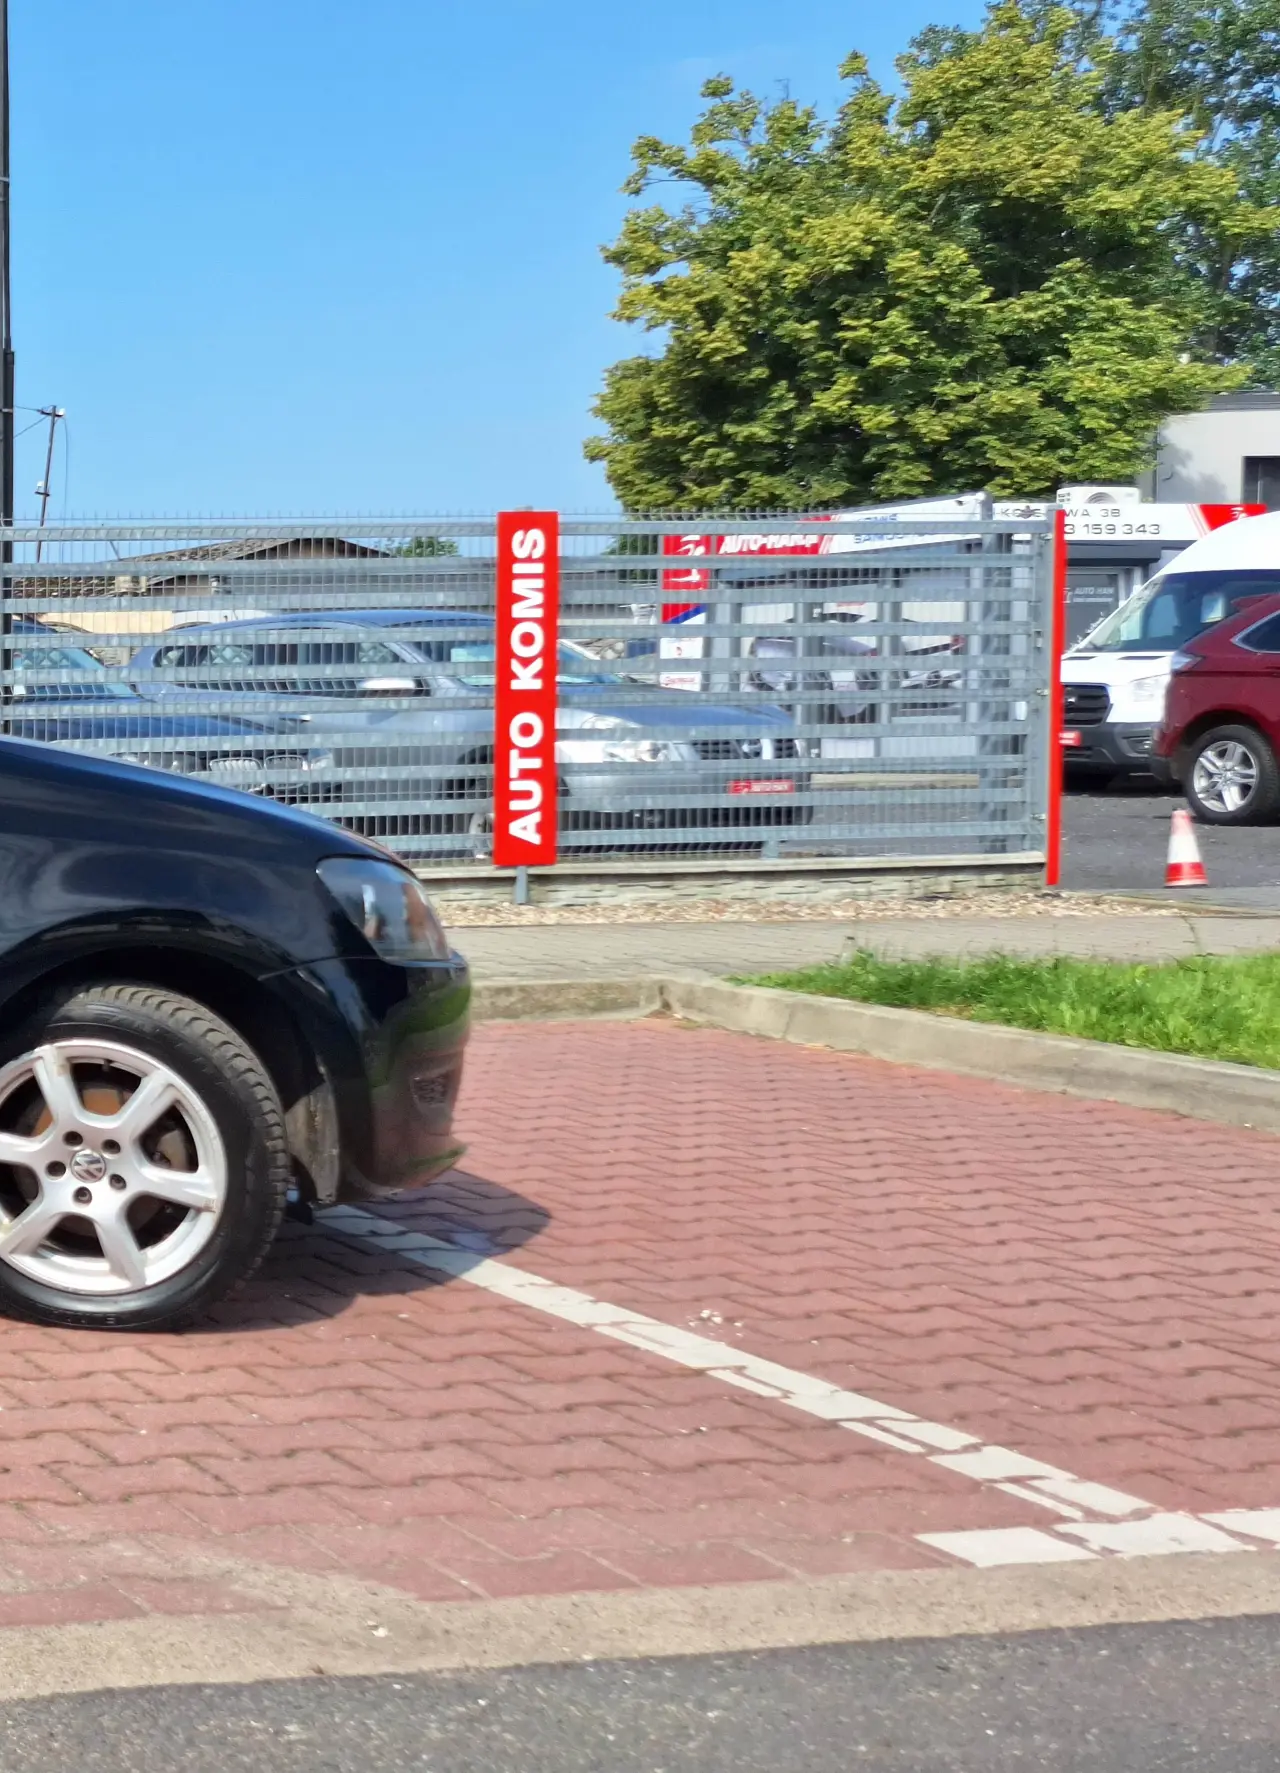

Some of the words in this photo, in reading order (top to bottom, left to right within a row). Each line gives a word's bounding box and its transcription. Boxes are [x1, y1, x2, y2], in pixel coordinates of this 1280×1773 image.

[1083, 523, 1116, 535] 159
[1122, 523, 1160, 535] 343
[510, 527, 546, 691] KOMIS
[508, 711, 542, 845] AUTO
